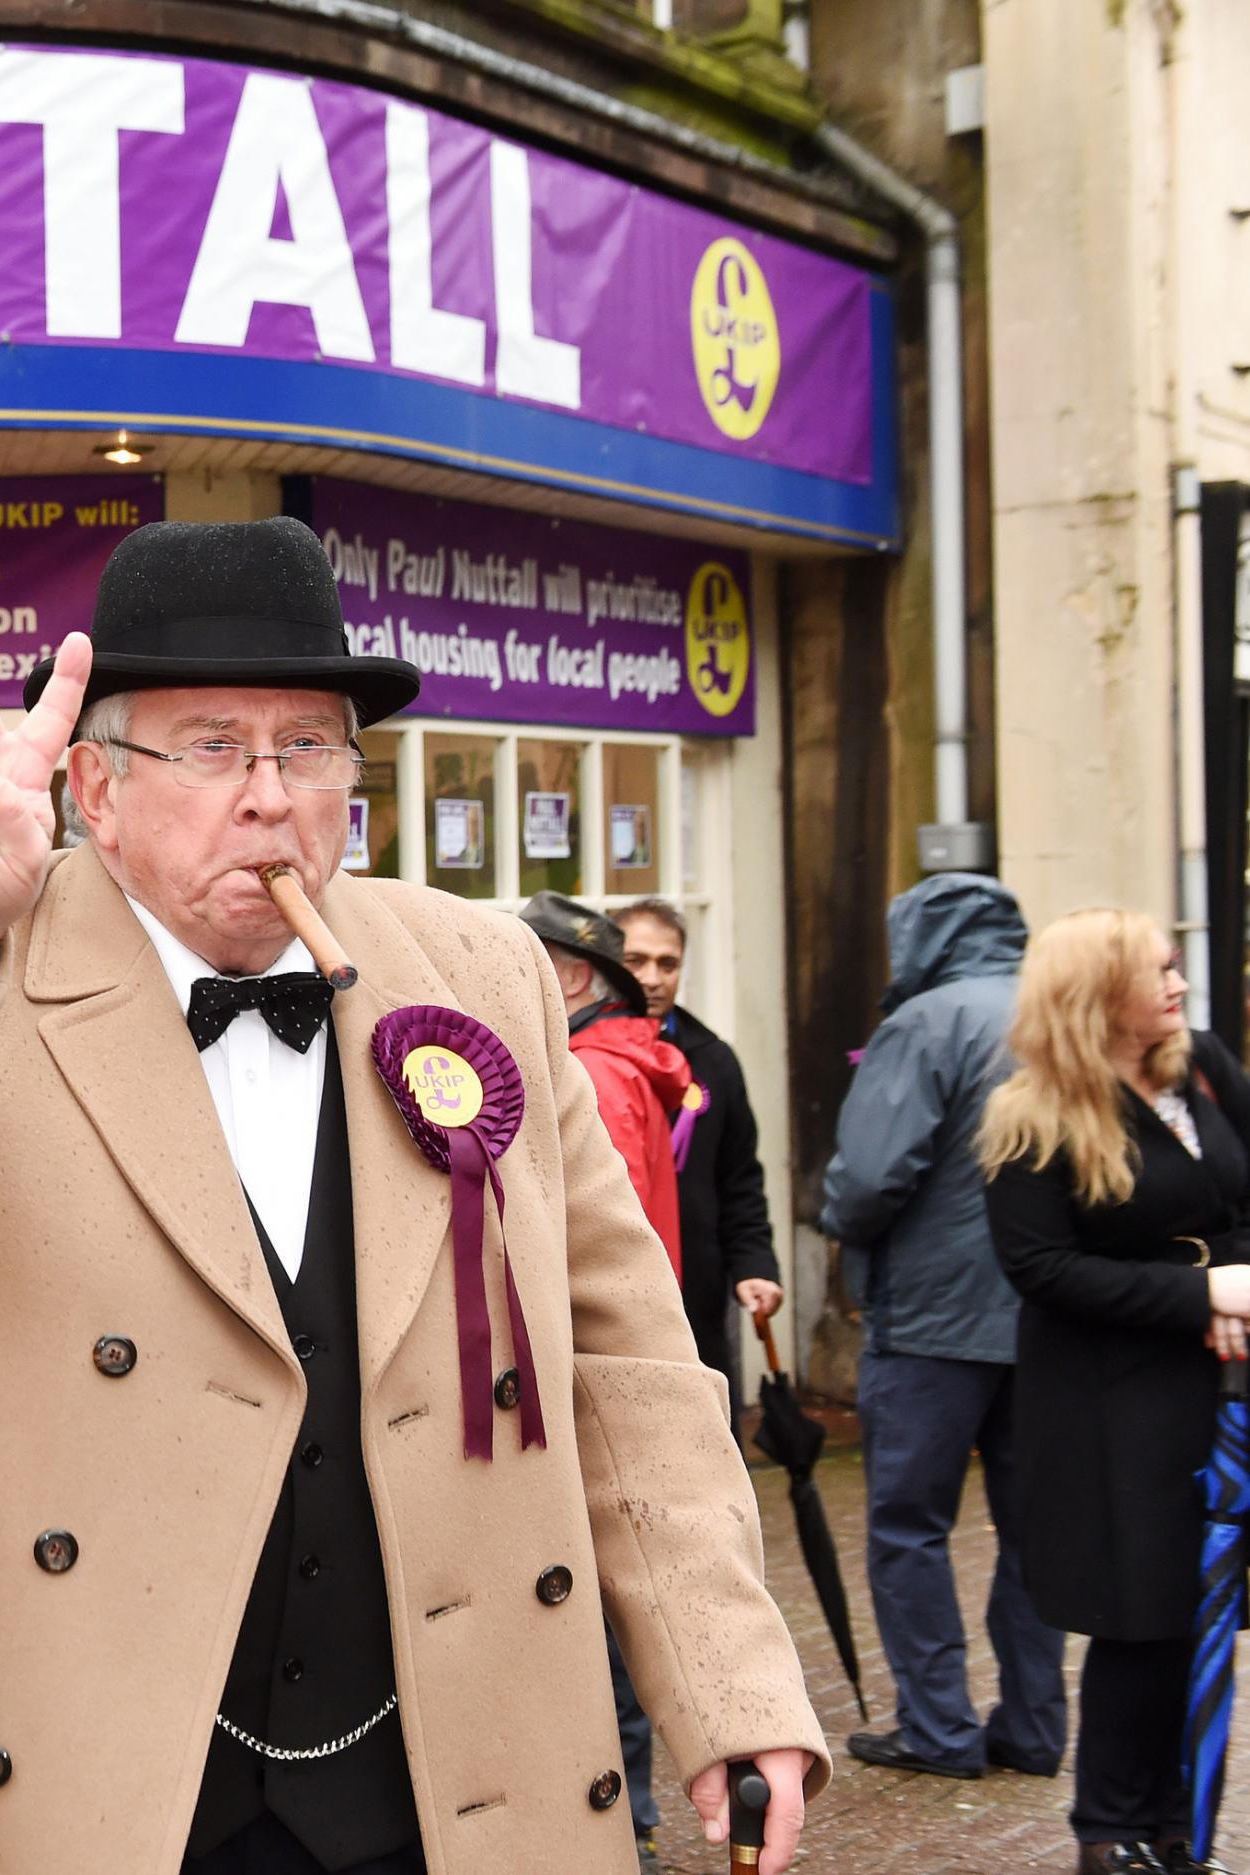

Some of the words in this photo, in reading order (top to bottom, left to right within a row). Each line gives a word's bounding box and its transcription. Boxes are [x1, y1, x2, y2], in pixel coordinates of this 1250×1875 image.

[703, 308, 767, 346] UKIP
[75, 499, 140, 527] will:
[322, 526, 379, 602] Only
[387, 538, 447, 599] Paul
[452, 549, 538, 608] Nuttall
[542, 563, 582, 615] will
[586, 571, 683, 627] prioritise
[400, 616, 503, 691] housing
[504, 628, 543, 684] for
[546, 634, 605, 690] local
[607, 646, 682, 704] people
[414, 1074, 465, 1088] UKIP
